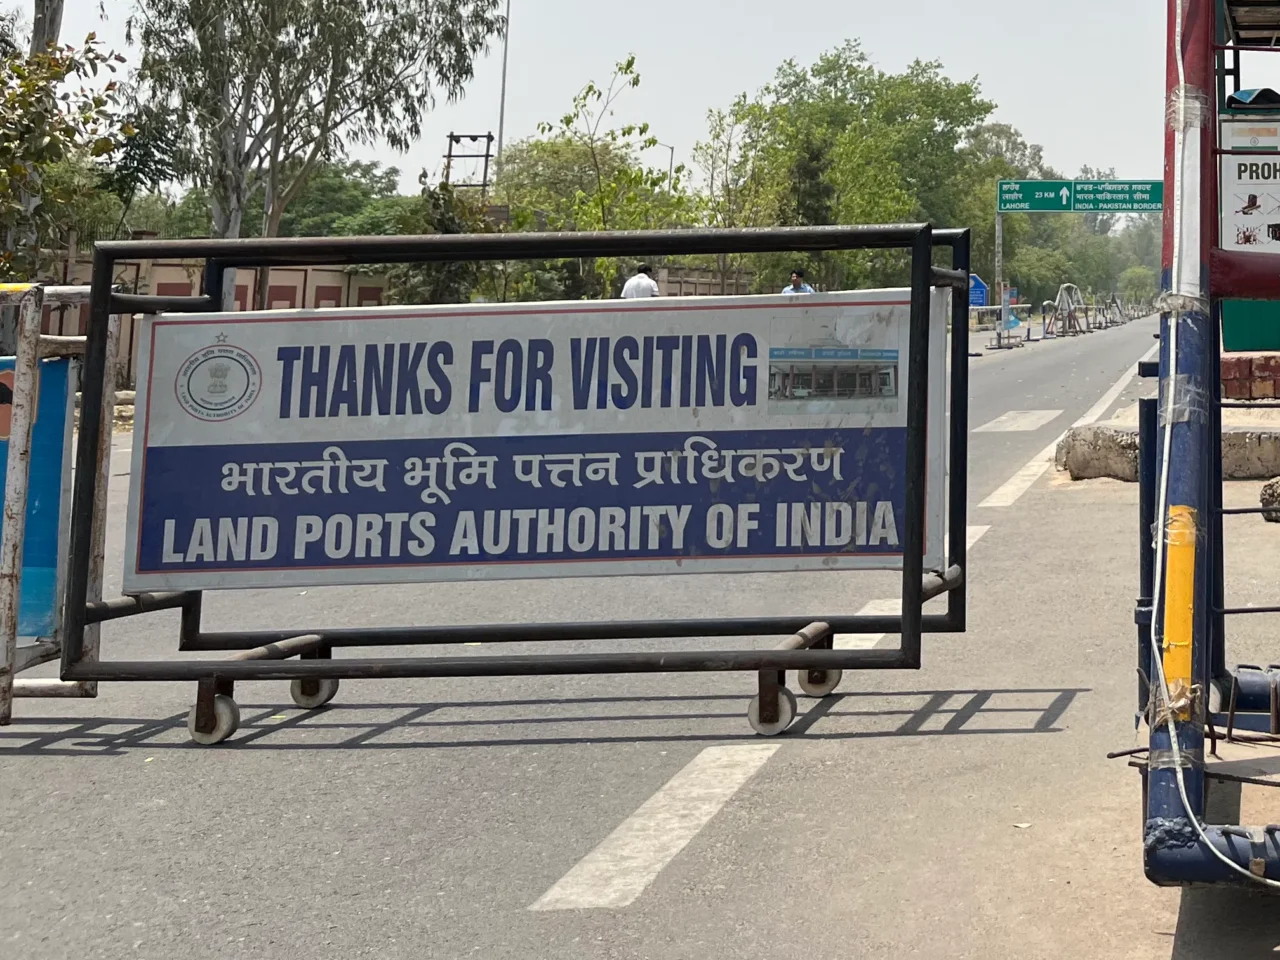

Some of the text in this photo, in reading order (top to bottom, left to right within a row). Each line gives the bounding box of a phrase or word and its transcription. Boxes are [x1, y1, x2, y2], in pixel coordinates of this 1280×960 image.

[276, 332, 758, 419] THANKS FOR VISITING
[220, 436, 846, 505] भारतीय भूमि पत्तन प्राधिकरण
[161, 500, 900, 564] LAND PORTS AUTHORITY OF INDIA
